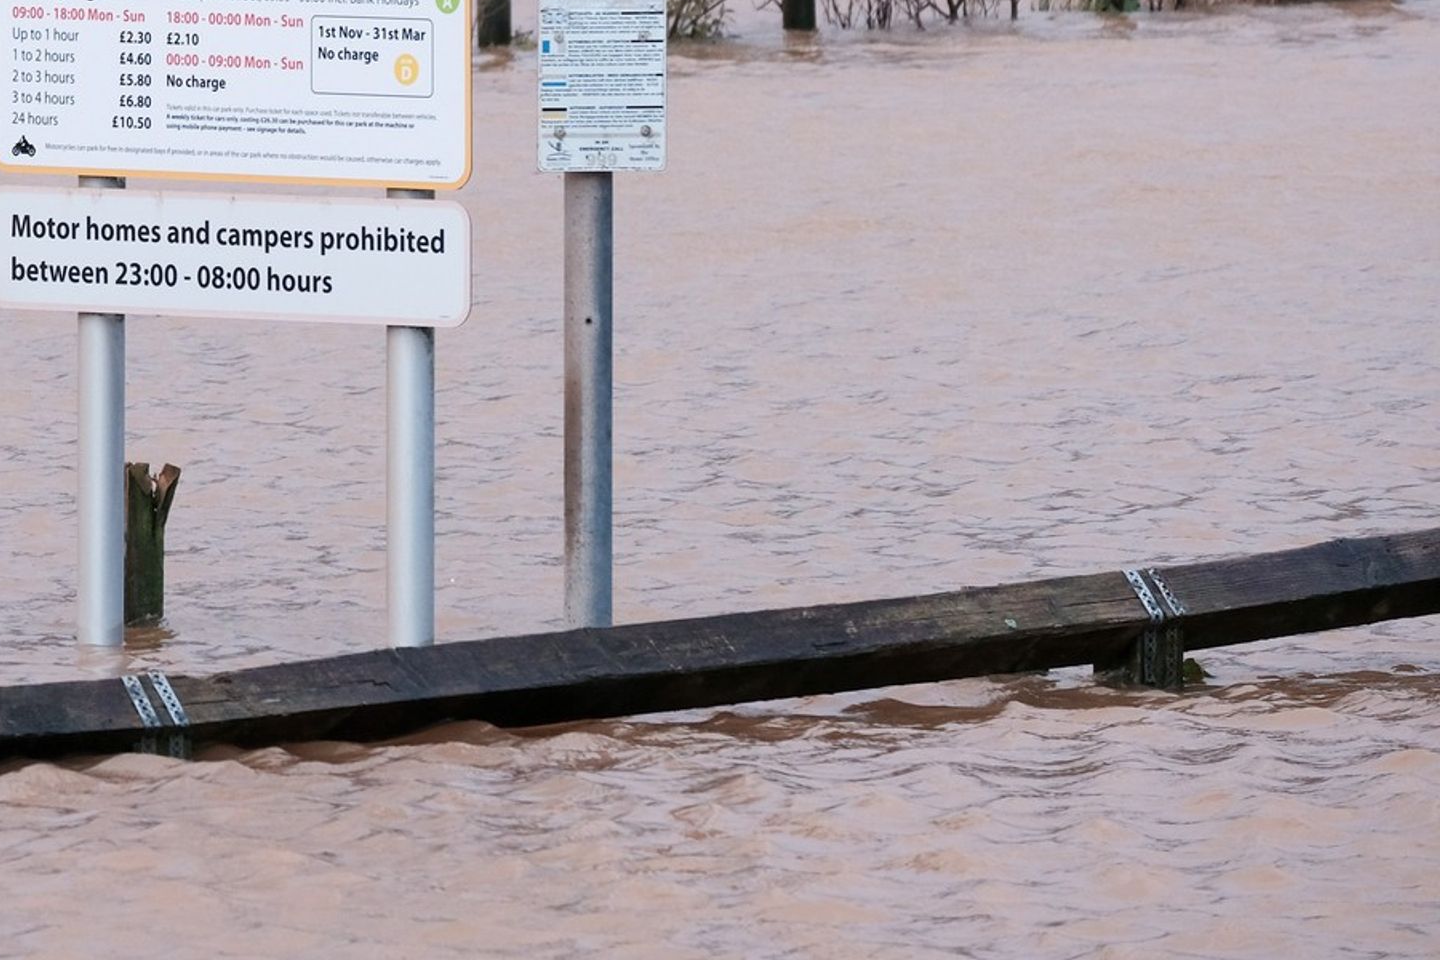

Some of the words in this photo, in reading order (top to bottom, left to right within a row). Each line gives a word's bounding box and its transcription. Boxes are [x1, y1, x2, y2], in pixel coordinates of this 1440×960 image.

[12, 6, 45, 20] 09:00
[54, 7, 85, 21] 18:00
[88, 8, 114, 22] Mon
[123, 9, 146, 23] Sun
[167, 11, 199, 25] 18:00
[208, 12, 242, 26] 00:00
[244, 13, 271, 27] Mon
[281, 14, 304, 28] Sun
[12, 27, 27, 42] Up
[30, 29, 42, 41] to
[45, 28, 50, 41] 1
[53, 28, 80, 42] hour
[119, 30, 152, 45] £2.30
[166, 32, 200, 46] £2.10
[318, 25, 336, 39] 1st
[339, 25, 363, 39] Nov
[373, 27, 399, 40] 31st
[402, 28, 426, 41] Mar
[13, 48, 18, 61] 1
[21, 50, 33, 62] to
[35, 49, 42, 62] 2
[44, 49, 75, 63] hours
[119, 52, 152, 66] £4.60
[166, 53, 199, 67] 00:00
[208, 54, 242, 68] 09:00
[244, 55, 271, 69] Mon
[281, 56, 304, 70] Sun
[318, 46, 335, 60] No
[337, 46, 379, 65] charge
[12, 69, 20, 83] 2
[21, 71, 33, 83] to
[35, 70, 42, 83] 3
[44, 71, 75, 85] hours
[119, 73, 152, 87] £5.80
[166, 74, 183, 88] No
[185, 75, 227, 92] charge
[12, 90, 20, 104] 3
[21, 92, 33, 104] to
[34, 91, 42, 104] 4
[44, 91, 75, 106] hours
[119, 94, 152, 108] £6.80
[12, 111, 26, 125] 24
[27, 112, 59, 126] hours
[112, 116, 152, 130] £10.50
[11, 213, 80, 241] Motor
[86, 216, 161, 243] homes
[167, 218, 210, 246] and
[215, 224, 314, 254] campers
[319, 225, 446, 256] prohibited
[11, 256, 109, 284] between
[114, 262, 178, 287] 23:00
[197, 265, 261, 291] 08:00
[266, 266, 333, 294] hours
